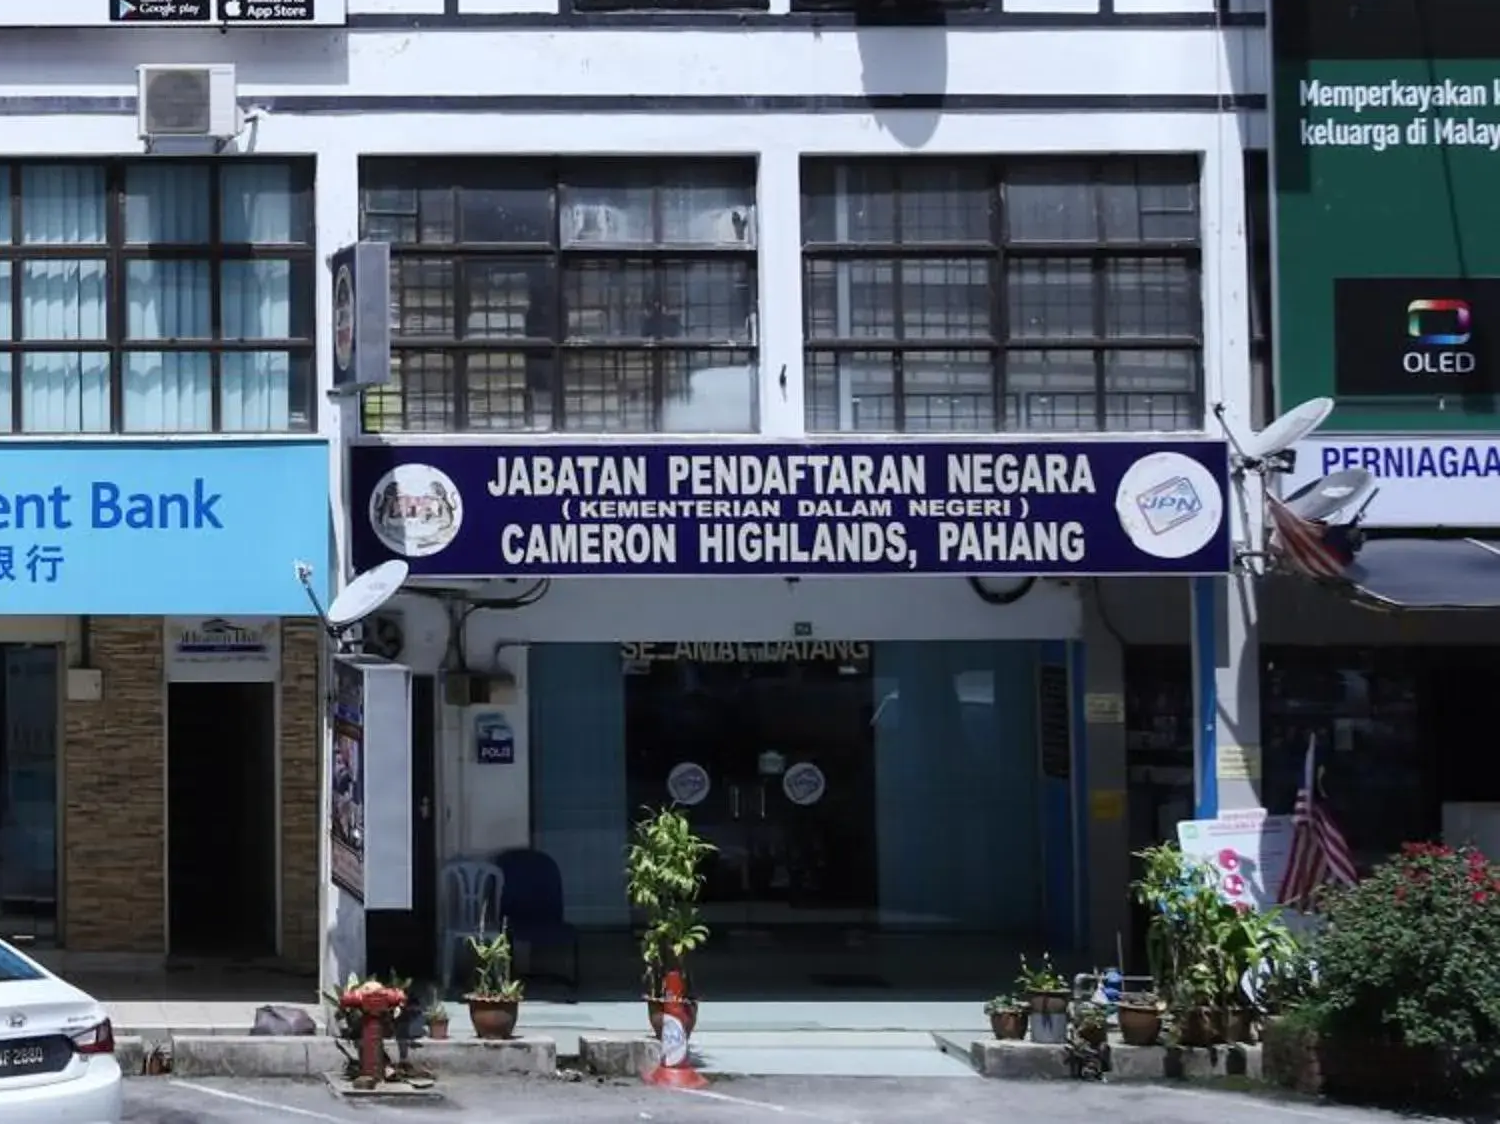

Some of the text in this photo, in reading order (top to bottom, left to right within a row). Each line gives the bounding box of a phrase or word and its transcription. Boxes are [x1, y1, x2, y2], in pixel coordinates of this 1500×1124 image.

[139, 3, 200, 17] Google play
[247, 3, 307, 18] App Store
[1300, 78, 1487, 114] Memperkayakan
[1300, 117, 1400, 151] keluarga
[1406, 117, 1428, 145] di
[1403, 351, 1475, 373] OLED
[487, 453, 1096, 497] JABATAN PENDAFTARAN NEGARA
[91, 477, 225, 530] Bank
[798, 499, 892, 517] DALAM
[1141, 496, 1197, 512] JPN
[501, 521, 1086, 569] CAMERON HIGHLANDS, PAHANG
